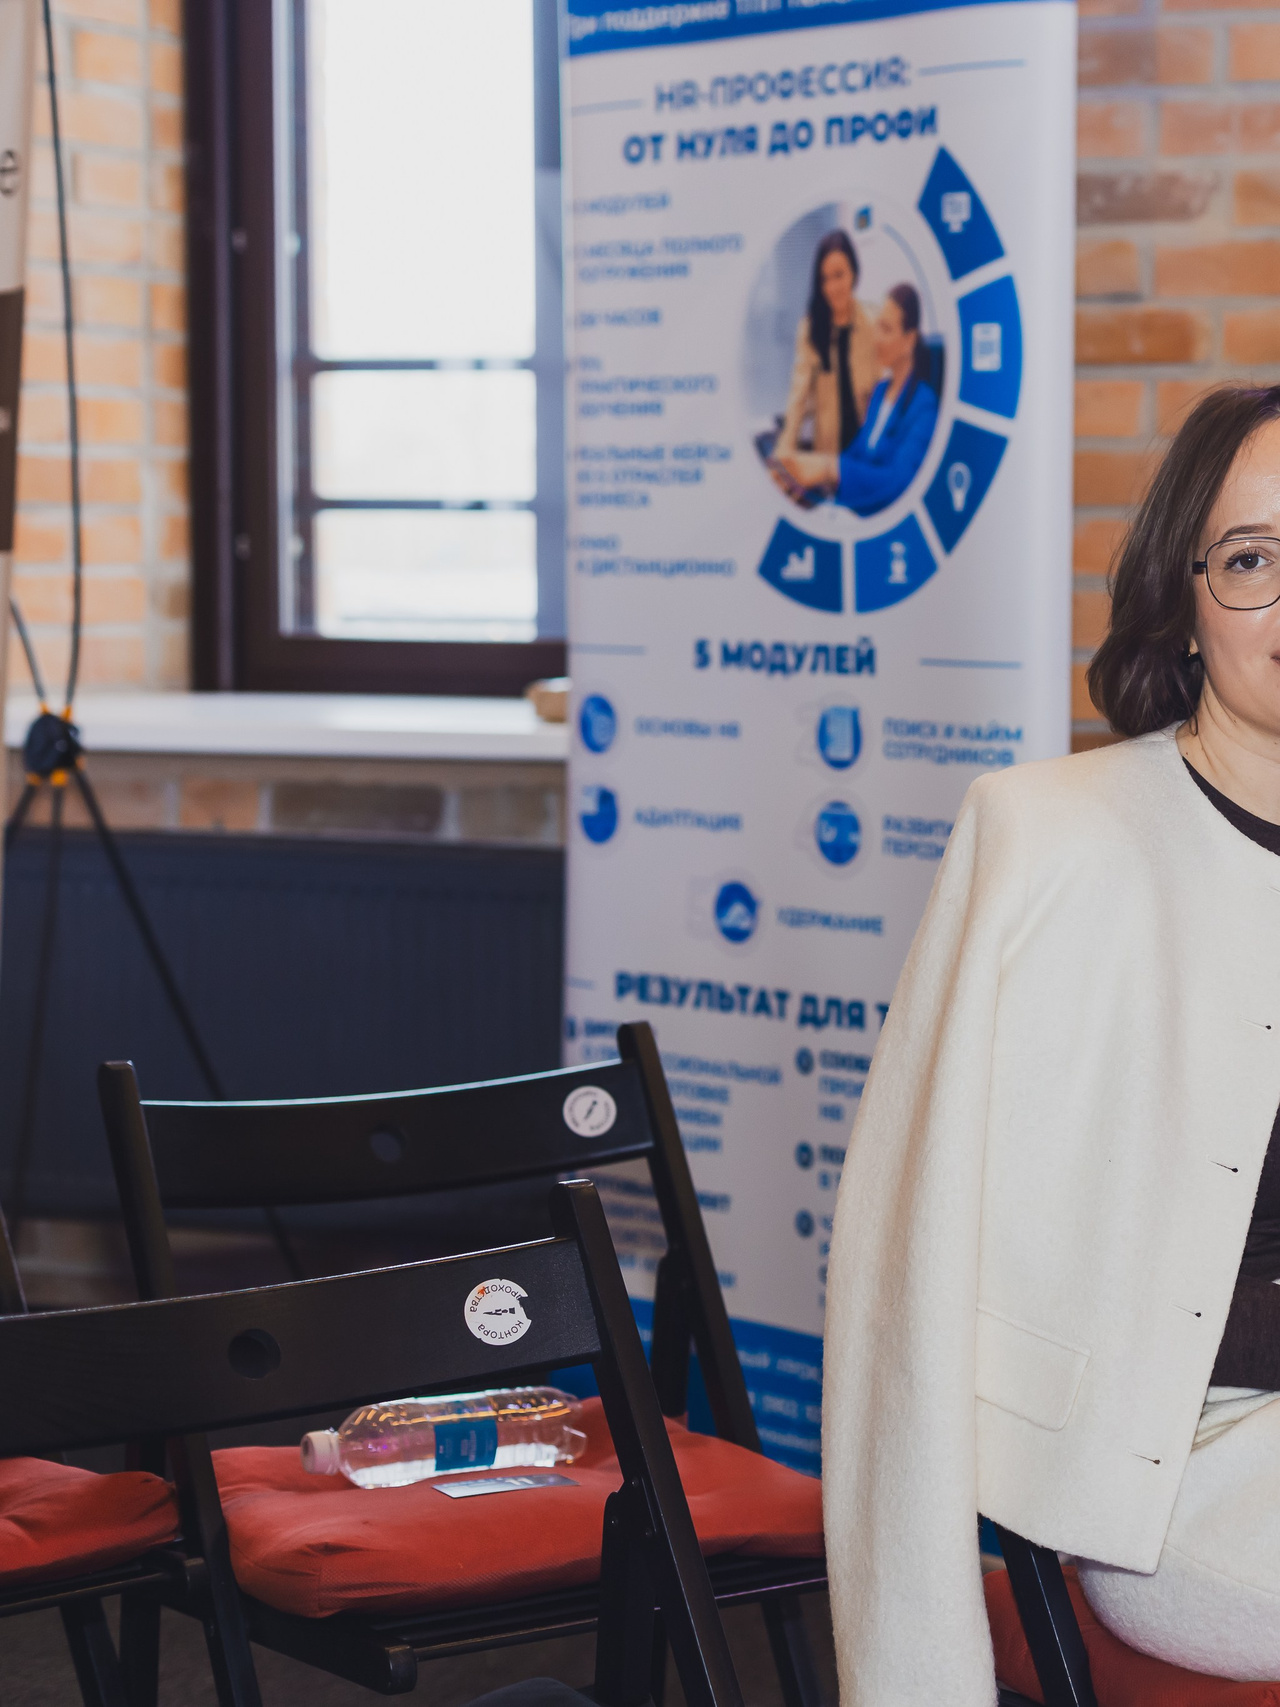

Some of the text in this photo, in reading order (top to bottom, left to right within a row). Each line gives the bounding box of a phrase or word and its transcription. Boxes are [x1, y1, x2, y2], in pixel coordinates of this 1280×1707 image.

[623, 105, 938, 165] ОТ НУЛЯ ДО ПРОФИ
[720, 636, 877, 677] МОДУЛЕЙ
[615, 970, 790, 1022] РЕЗУЛЬТАТ
[798, 993, 866, 1034] ДЛЯ
